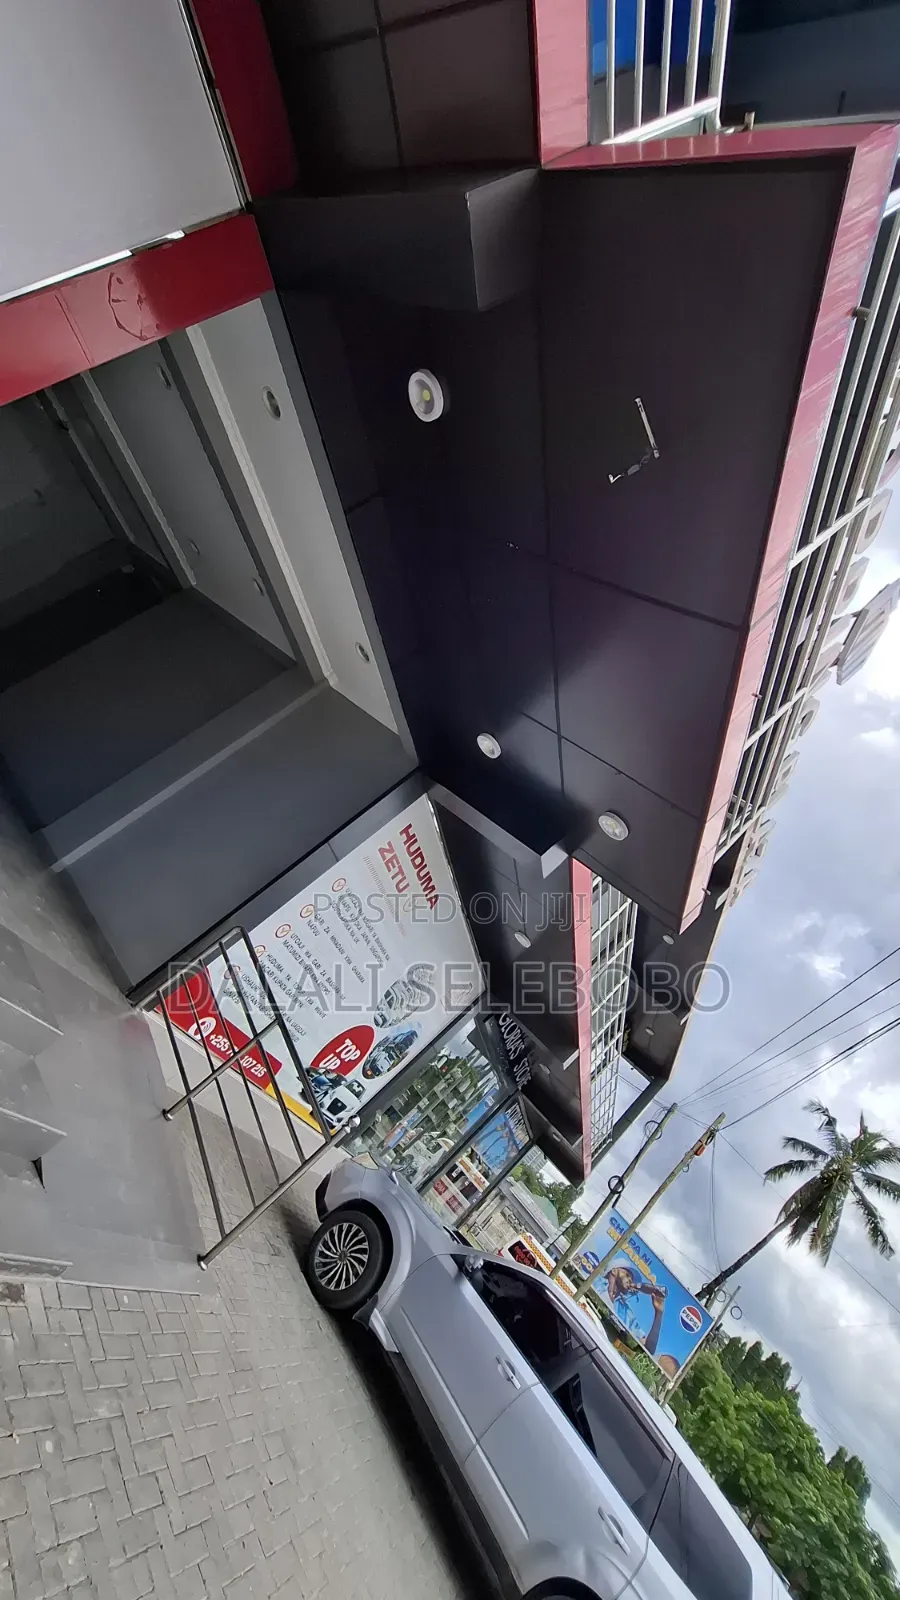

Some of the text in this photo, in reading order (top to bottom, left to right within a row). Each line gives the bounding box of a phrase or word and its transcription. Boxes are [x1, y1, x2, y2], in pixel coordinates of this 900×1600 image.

[378, 840, 410, 894] ZETU
[399, 823, 440, 911] HUDUMA
[305, 919, 320, 937] NAFUU
[281, 939, 302, 961] MATUMIZI
[289, 932, 305, 950] UTOAJI
[303, 949, 312, 959] WA
[310, 958, 321, 970] GARI
[319, 969, 327, 977] ZA
[313, 912, 365, 984] GARI ZA MNADANI KWA GHARAMA
[265, 952, 285, 973] HUDUMA
[284, 973, 292, 981] YA
[272, 975, 289, 991] KUPATA
[335, 1038, 361, 1064] TOP
[498, 1011, 525, 1060] GLORIA'S
[209, 1034, 231, 1051] +255
[239, 1055, 257, 1068] 107
[250, 1063, 267, 1077] 215
[318, 1052, 340, 1070] UP
[608, 1215, 643, 1255] CHPA
[681, 1308, 700, 1330] PEPSI
